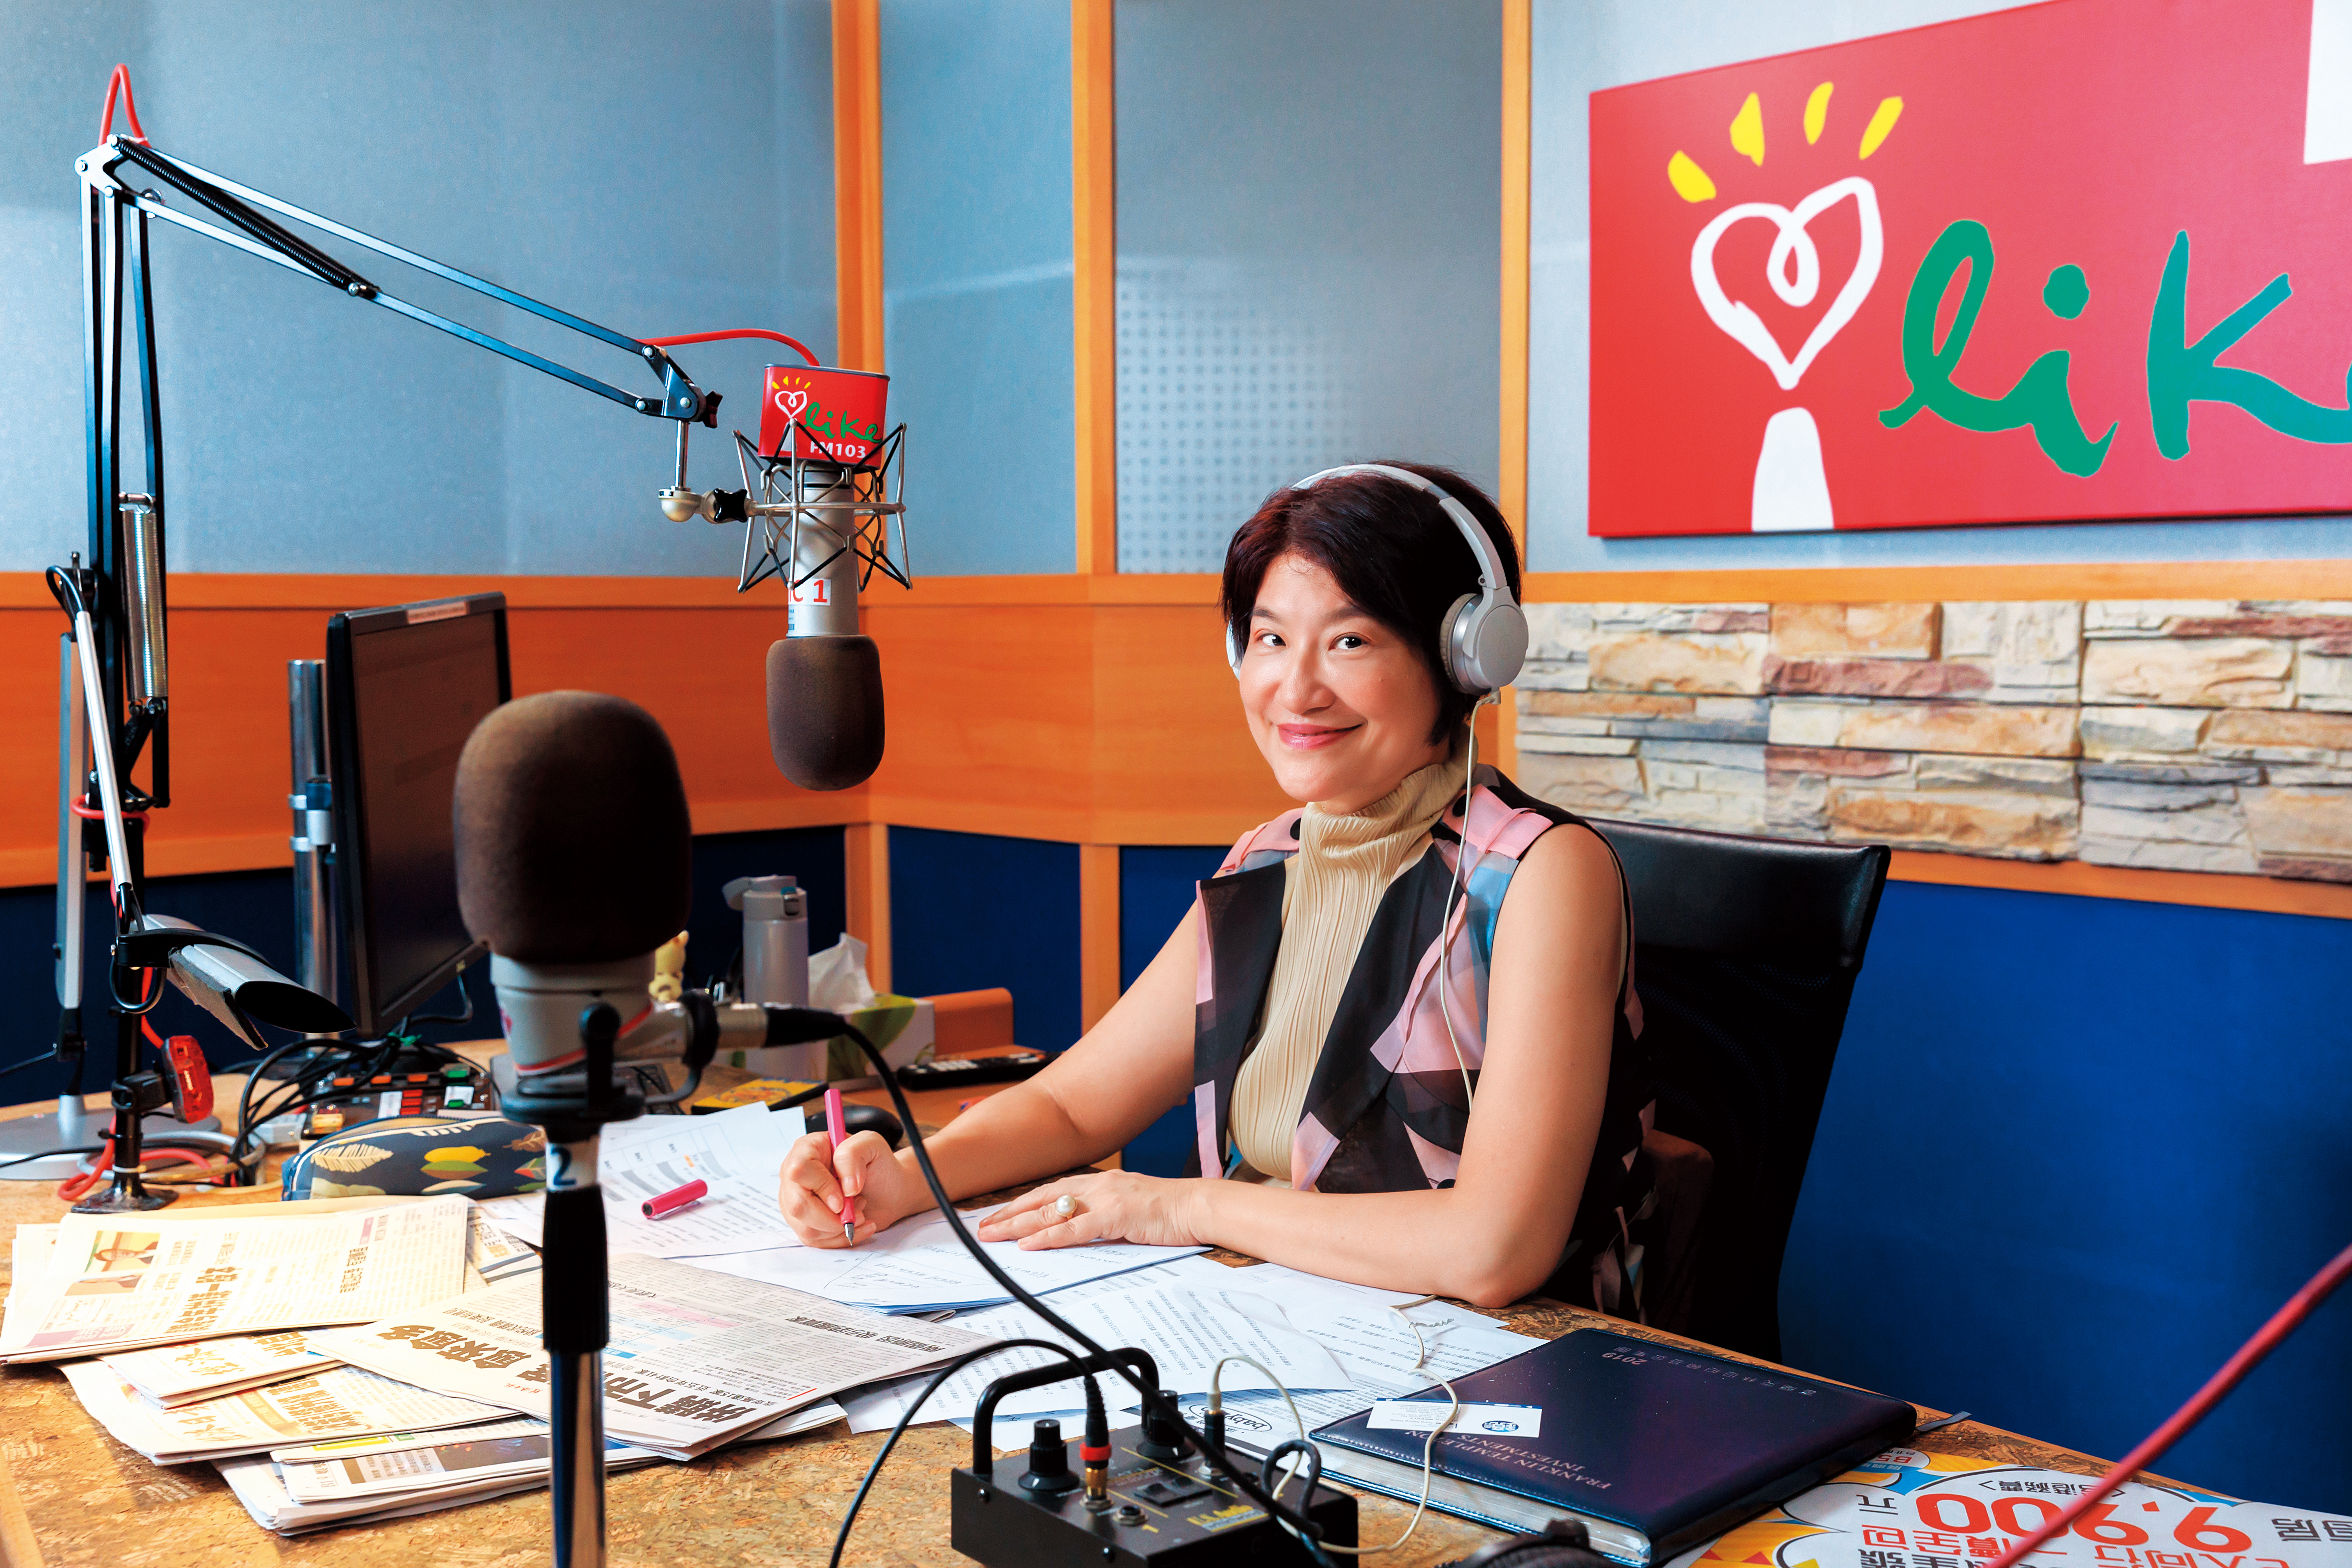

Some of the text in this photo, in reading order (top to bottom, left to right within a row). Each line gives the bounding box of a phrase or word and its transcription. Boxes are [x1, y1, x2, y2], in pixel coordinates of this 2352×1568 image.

[1879, 219, 2352, 477] lik
[803, 402, 882, 443] like
[810, 441, 866, 459] FM103
[813, 579, 828, 603] 1
[550, 1147, 577, 1185] 2
[375, 1325, 532, 1368] 愈來愈多
[1389, 1336, 1410, 1345] France
[1602, 1351, 1647, 1364] 2019
[635, 1368, 710, 1391] 近五年合計41家
[709, 1388, 777, 1406] 去年高達15家
[1405, 1430, 1612, 1489] FRANKLIN TEMPLEON
[1457, 1434, 1585, 1471] INVESTMENTS
[1856, 1494, 1898, 1515] 元
